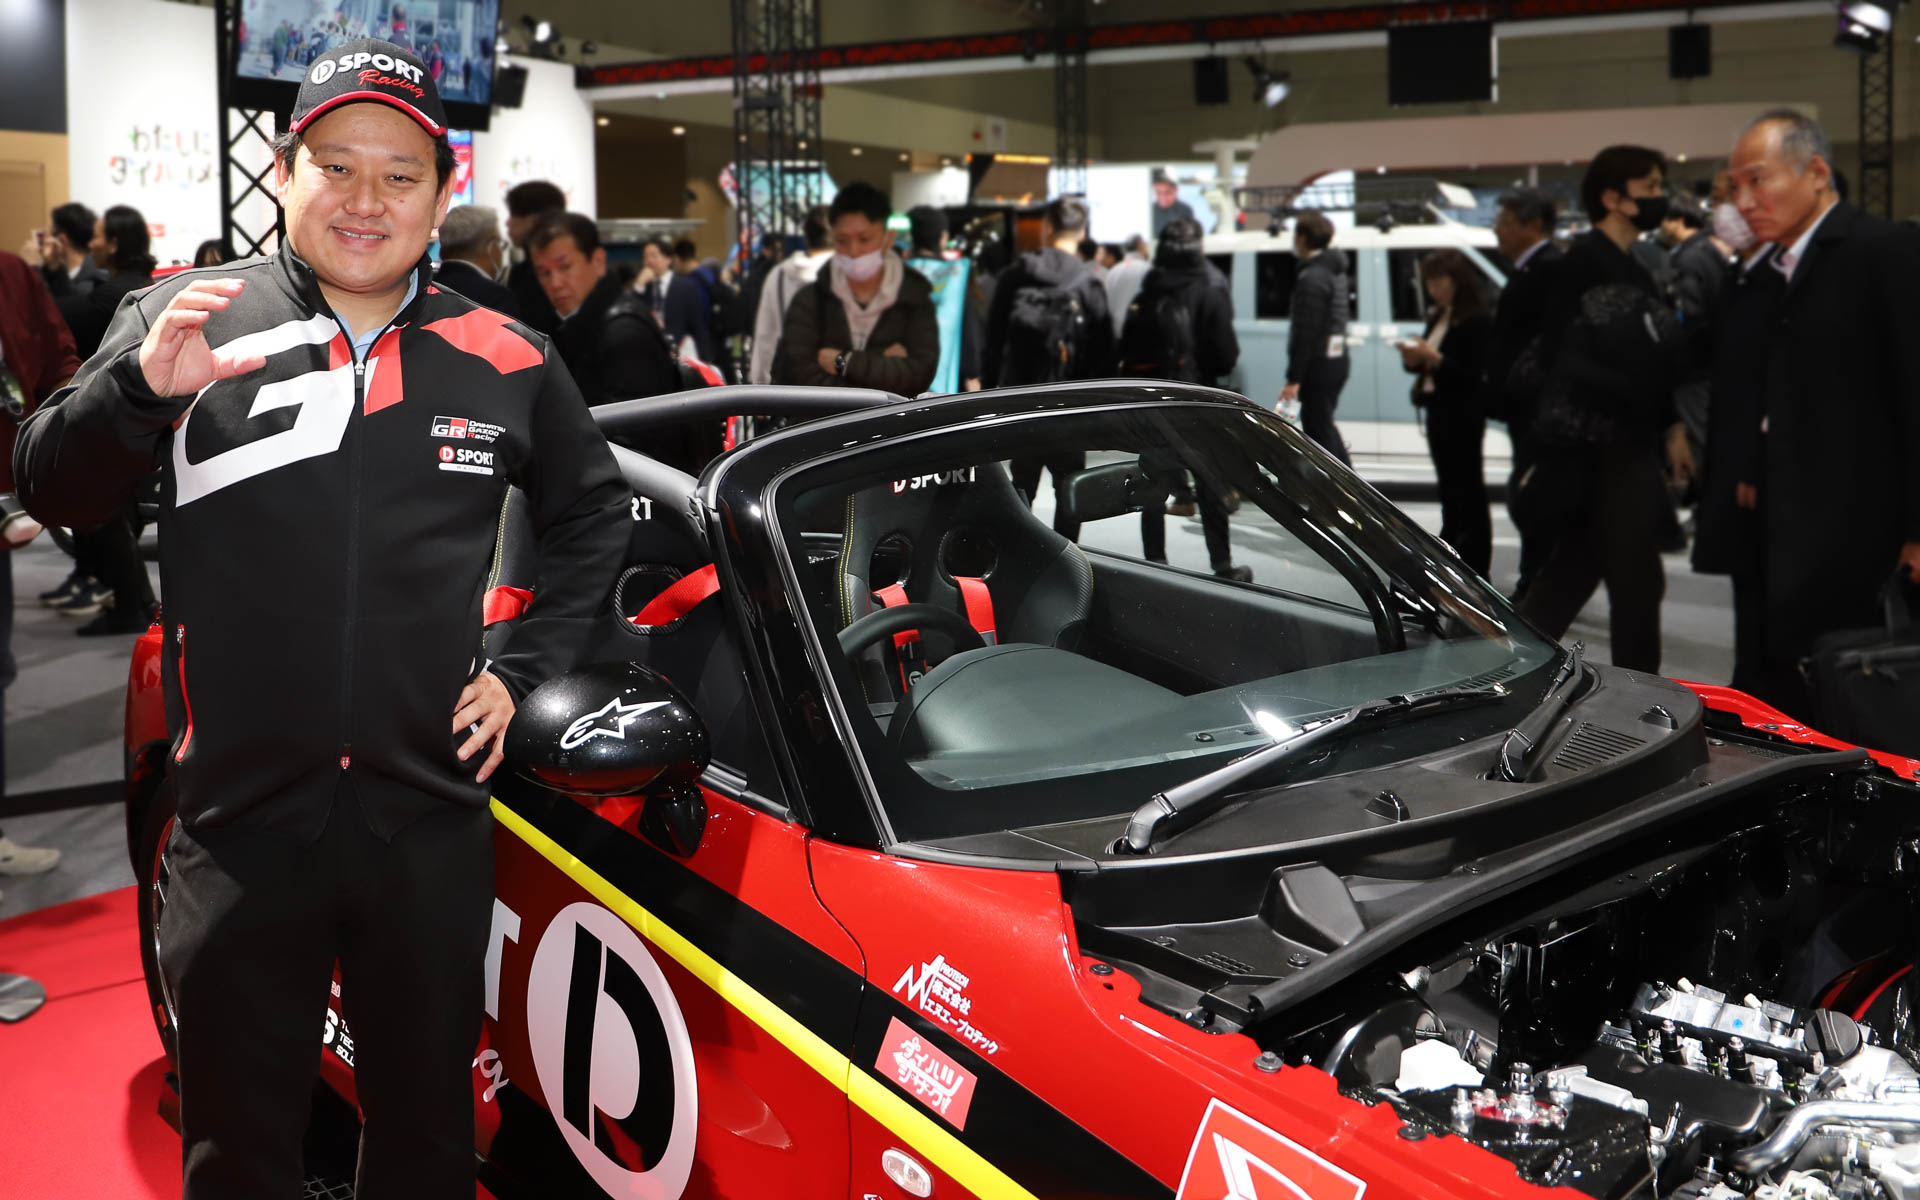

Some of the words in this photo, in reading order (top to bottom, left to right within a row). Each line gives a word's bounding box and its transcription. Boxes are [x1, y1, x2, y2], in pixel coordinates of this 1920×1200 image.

[337, 52, 424, 84] SPORT
[357, 69, 425, 98] Racing
[433, 424, 464, 437] GR
[467, 426, 499, 437] GAZOO
[467, 432, 496, 443] Racing
[440, 446, 454, 461] D
[456, 448, 494, 466] SPORT
[931, 979, 971, 1016] 株式会社
[924, 998, 999, 1055] エヌエープロテック
